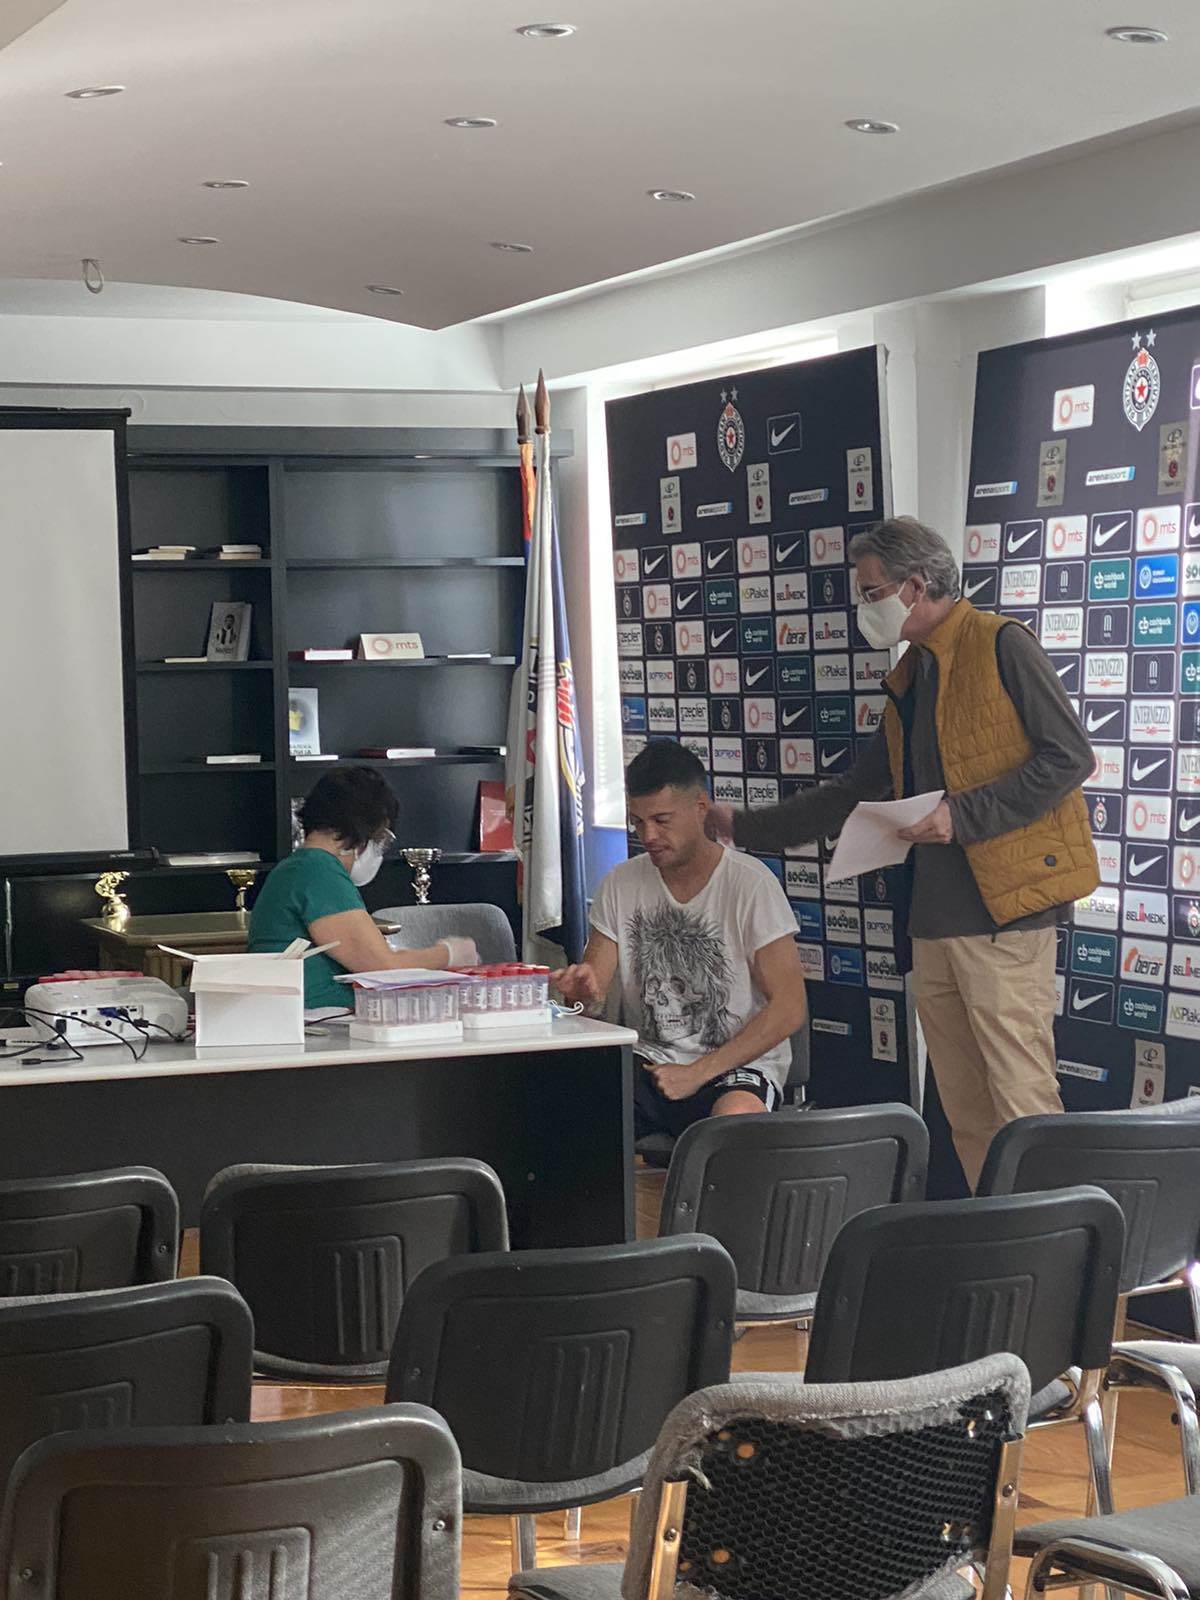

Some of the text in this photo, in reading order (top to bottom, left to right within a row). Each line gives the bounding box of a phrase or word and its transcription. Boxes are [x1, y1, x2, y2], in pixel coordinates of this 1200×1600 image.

[1074, 400, 1090, 413] mts
[1088, 471, 1126, 482] arenasport
[1160, 522, 1177, 536] mts
[1068, 530, 1083, 542] mts
[396, 641, 418, 649] mts
[1104, 761, 1120, 773] mts
[1150, 812, 1167, 824] mts
[1101, 856, 1117, 868] mts
